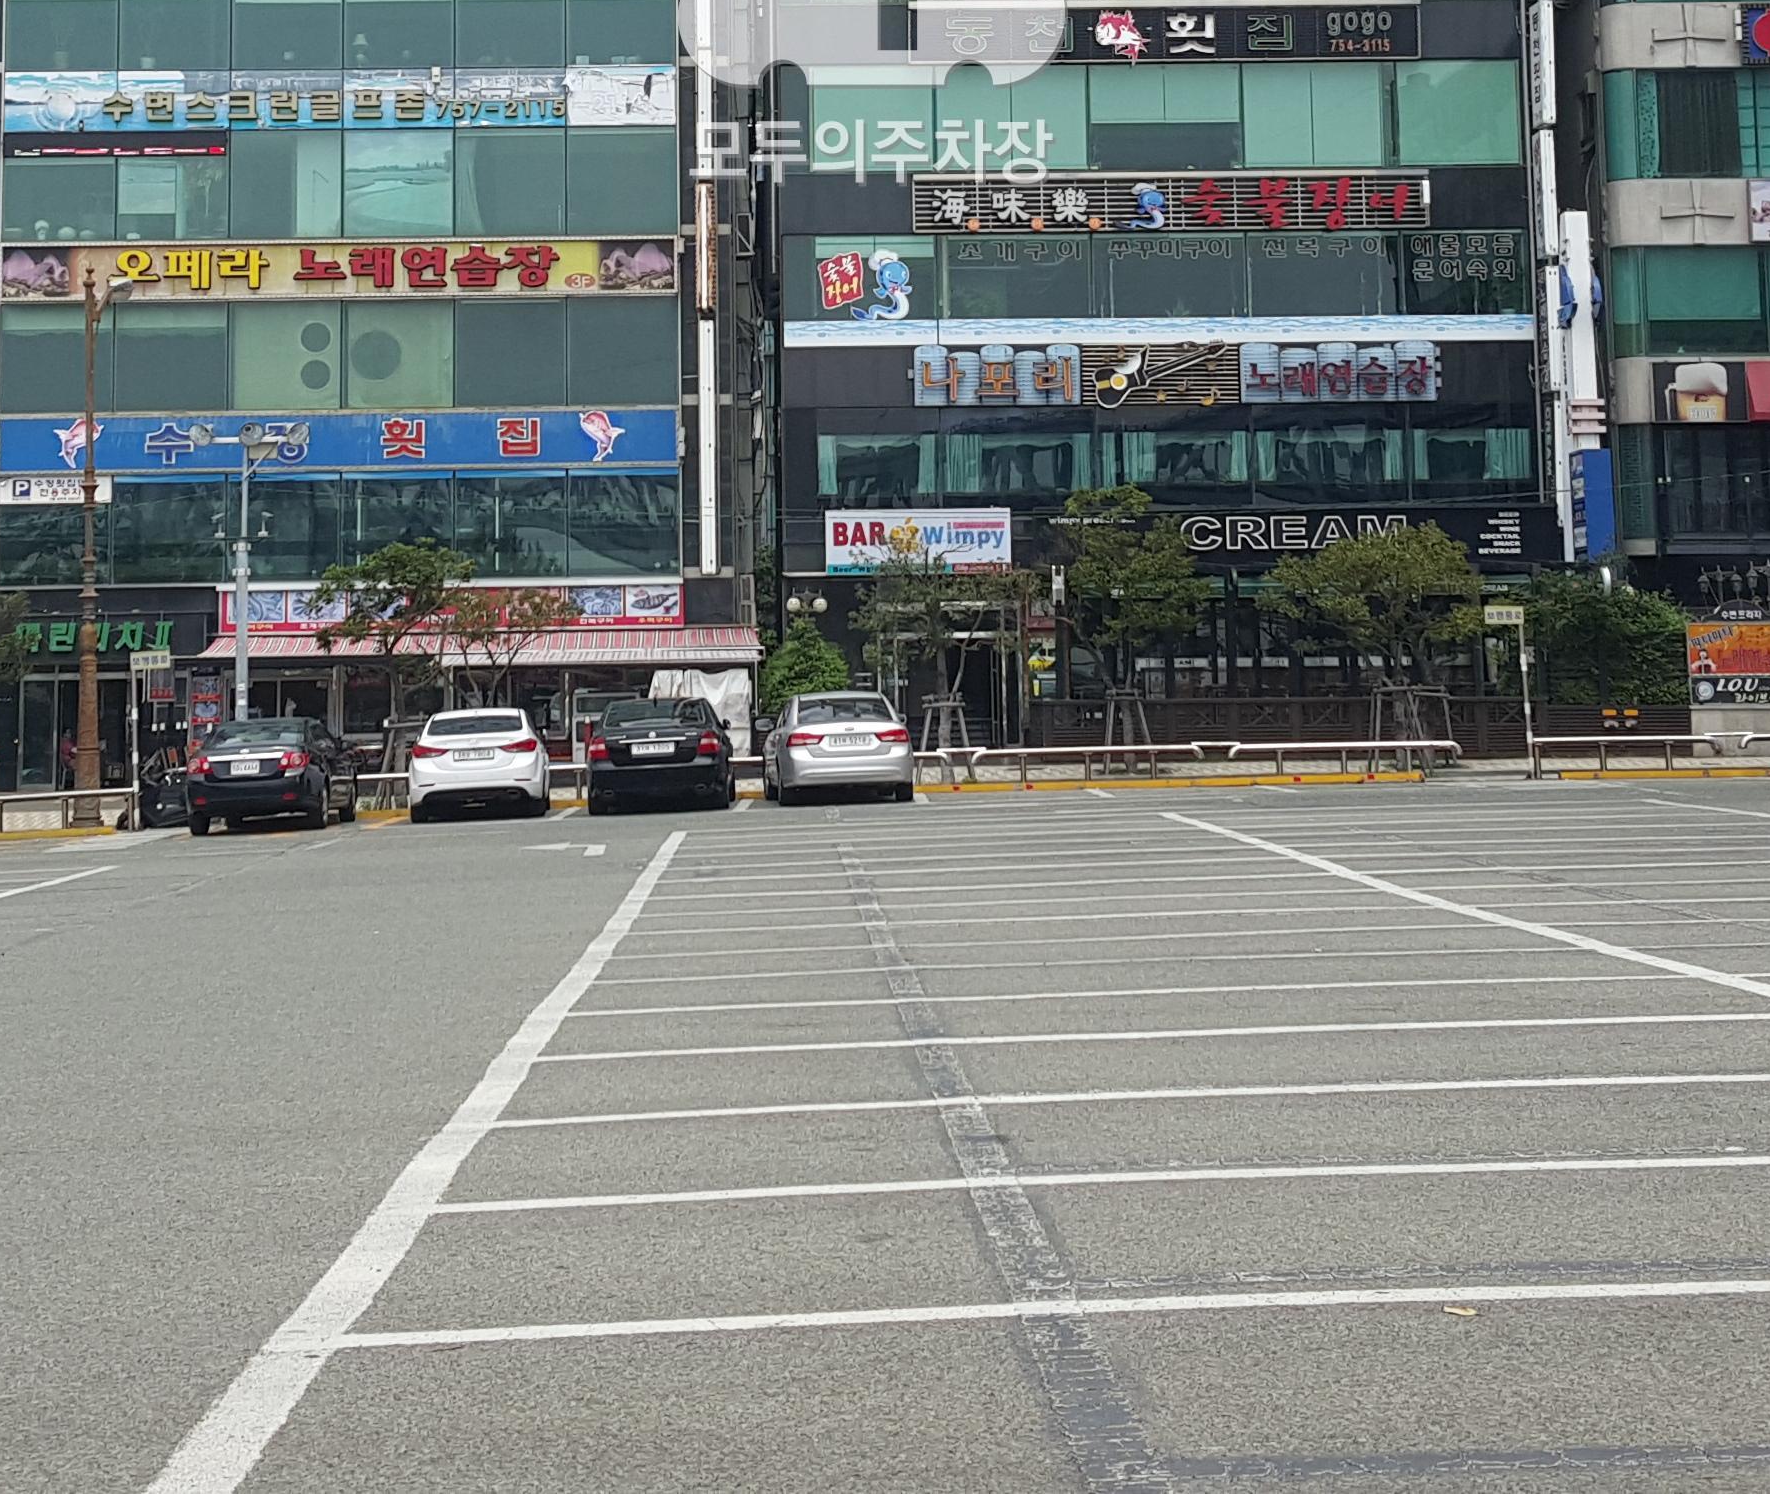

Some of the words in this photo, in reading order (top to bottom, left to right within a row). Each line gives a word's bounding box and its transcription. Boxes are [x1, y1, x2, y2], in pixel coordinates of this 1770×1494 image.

[1168, 13, 1293, 54] 횟집
[1326, 12, 1394, 34] gogo
[436, 98, 566, 119] 757-2115
[294, 246, 561, 288] 노래연습장
[922, 360, 1073, 401] 나포리
[1248, 358, 1434, 399] 노래연습장
[381, 417, 540, 459] 횟집
[833, 522, 885, 547] BAR
